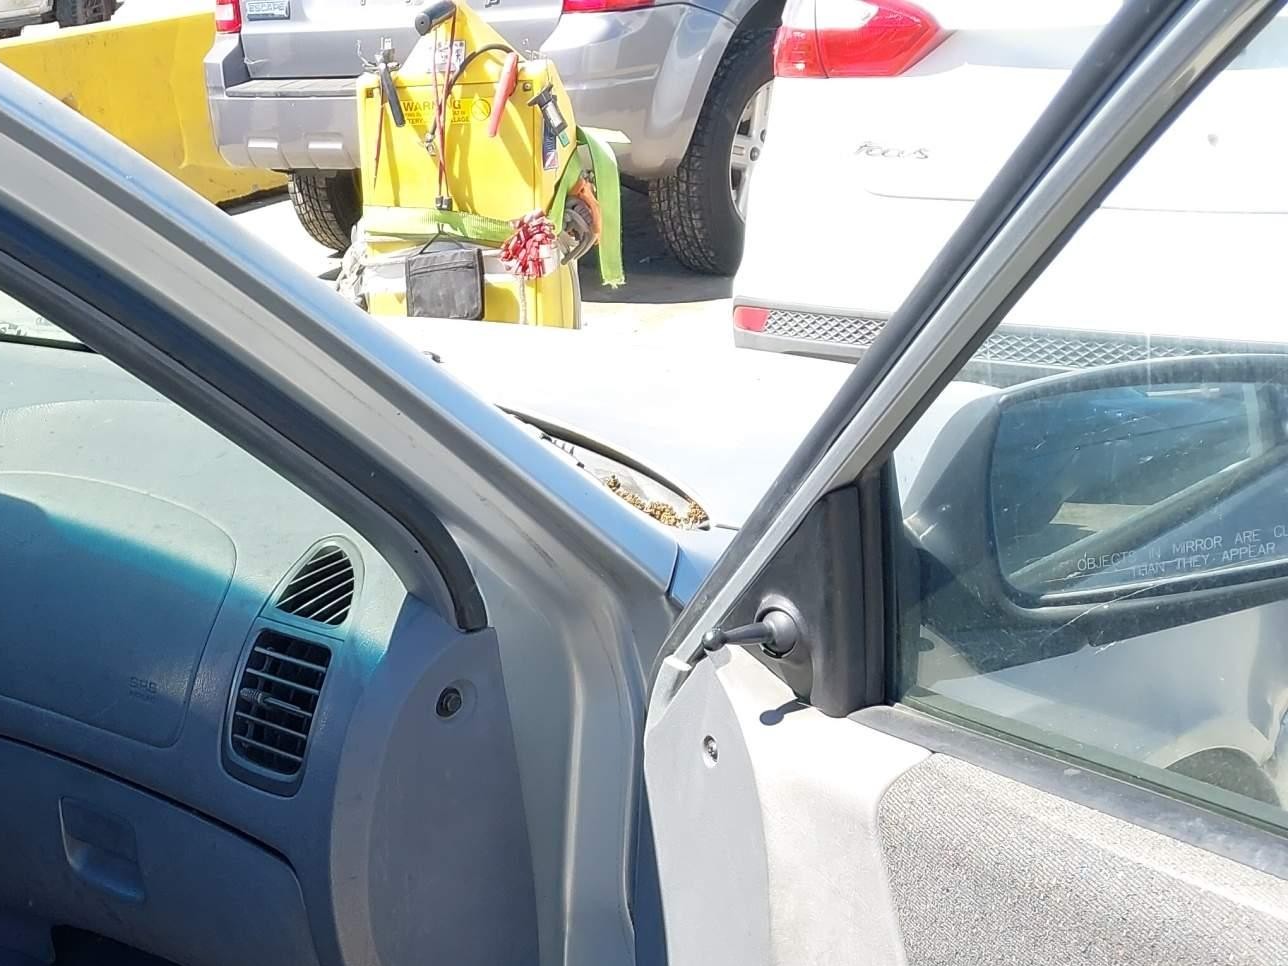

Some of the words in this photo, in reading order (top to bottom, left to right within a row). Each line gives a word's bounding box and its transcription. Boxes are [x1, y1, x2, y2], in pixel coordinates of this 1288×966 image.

[1077, 551, 1136, 570] OBJECTS
[1149, 548, 1160, 559] IN
[1172, 535, 1223, 554] MIRROR
[1235, 529, 1260, 545] ARE
[1131, 563, 1165, 577] THAN
[1176, 554, 1209, 569] THEY
[1222, 542, 1276, 561] APPEAR
